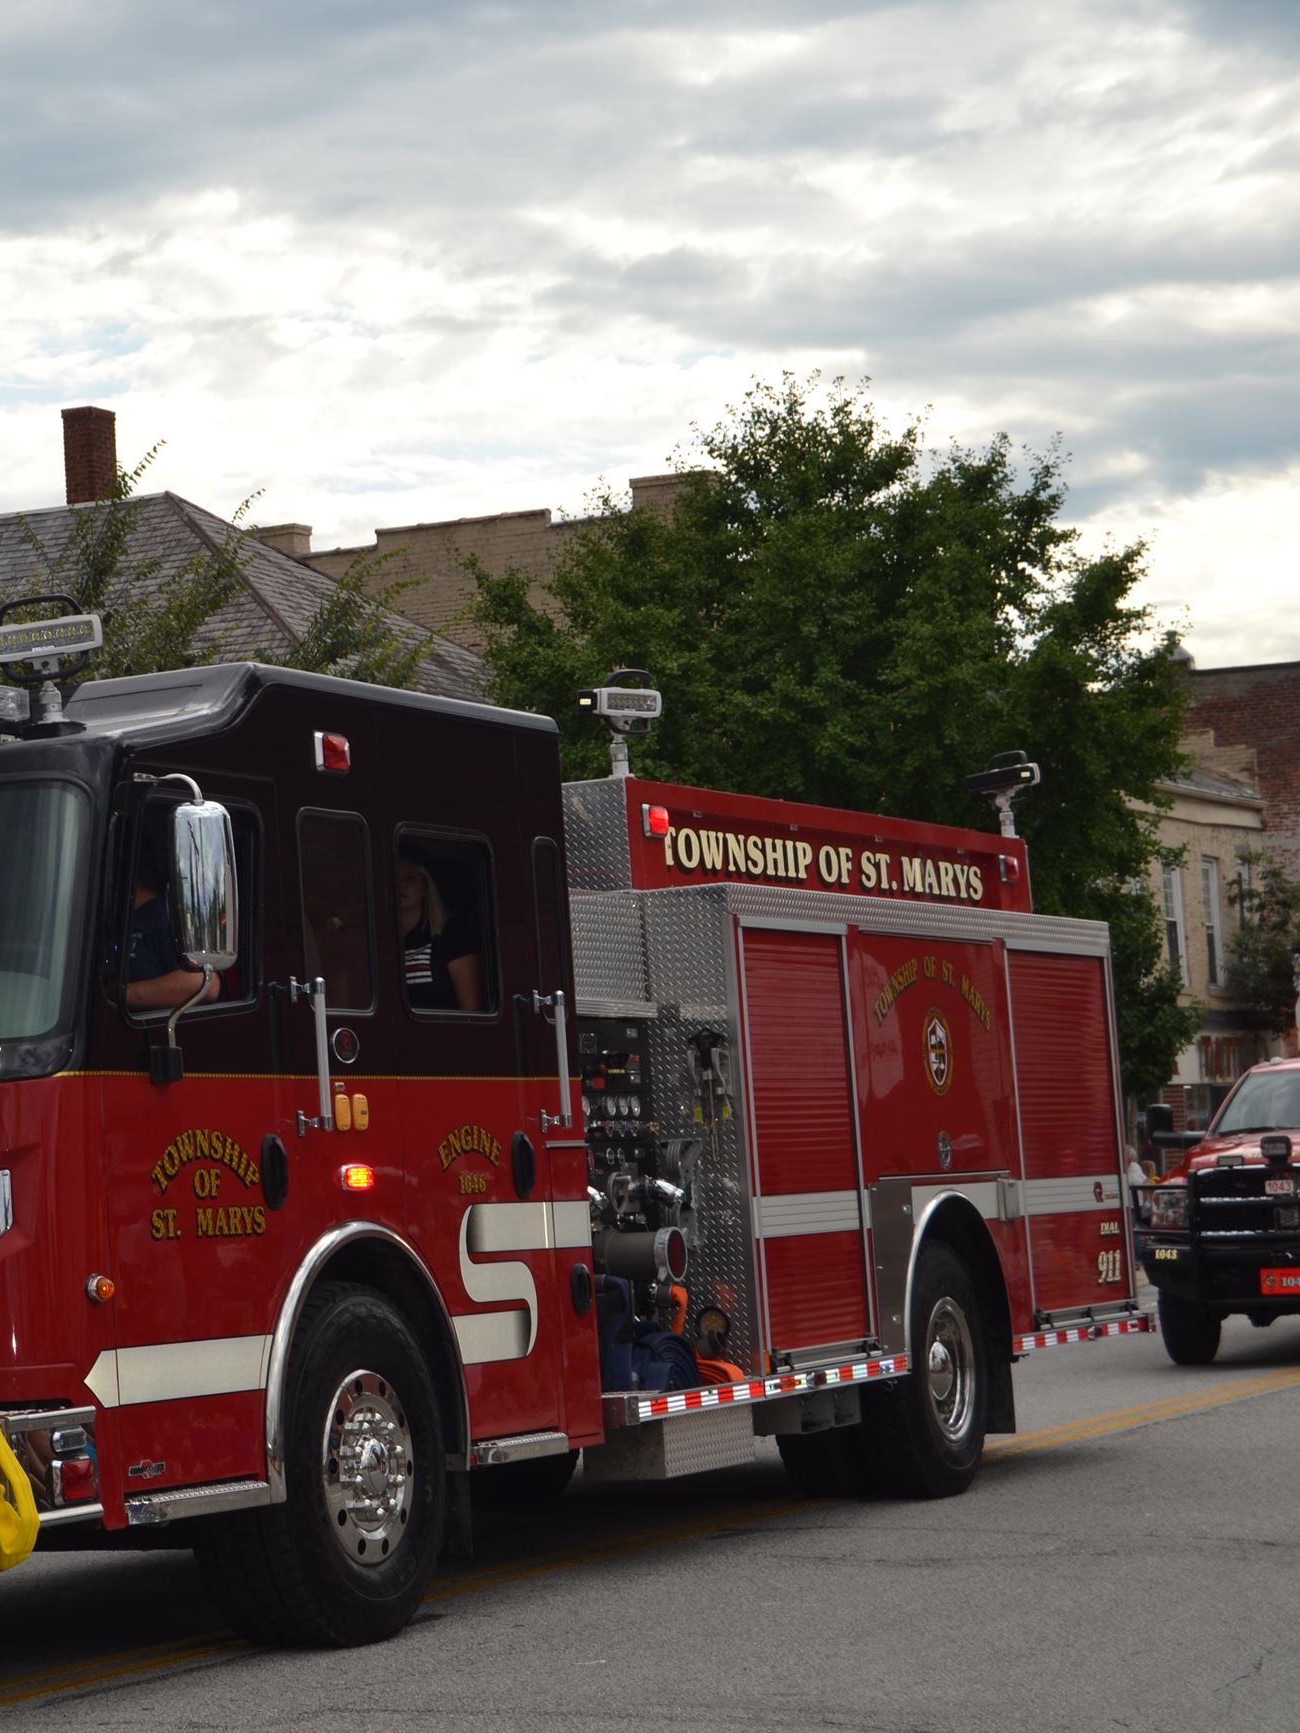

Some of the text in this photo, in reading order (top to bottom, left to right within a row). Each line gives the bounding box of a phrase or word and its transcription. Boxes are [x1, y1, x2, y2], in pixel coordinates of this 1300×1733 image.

[665, 826, 984, 900] TOWNSHIP OF ST. MARYS
[874, 956, 991, 1031] TOWNSHIP OF ST. MARYS
[151, 1128, 261, 1192] TOWNSHIP
[438, 1124, 502, 1170] ENGINE
[194, 1168, 221, 1198] OF
[460, 1174, 486, 1194] 1046
[1266, 1181, 1292, 1193] 1043
[151, 1205, 266, 1239] ST. MARYS
[1100, 1221, 1120, 1235] DIAL
[1097, 1249, 1121, 1284] 911
